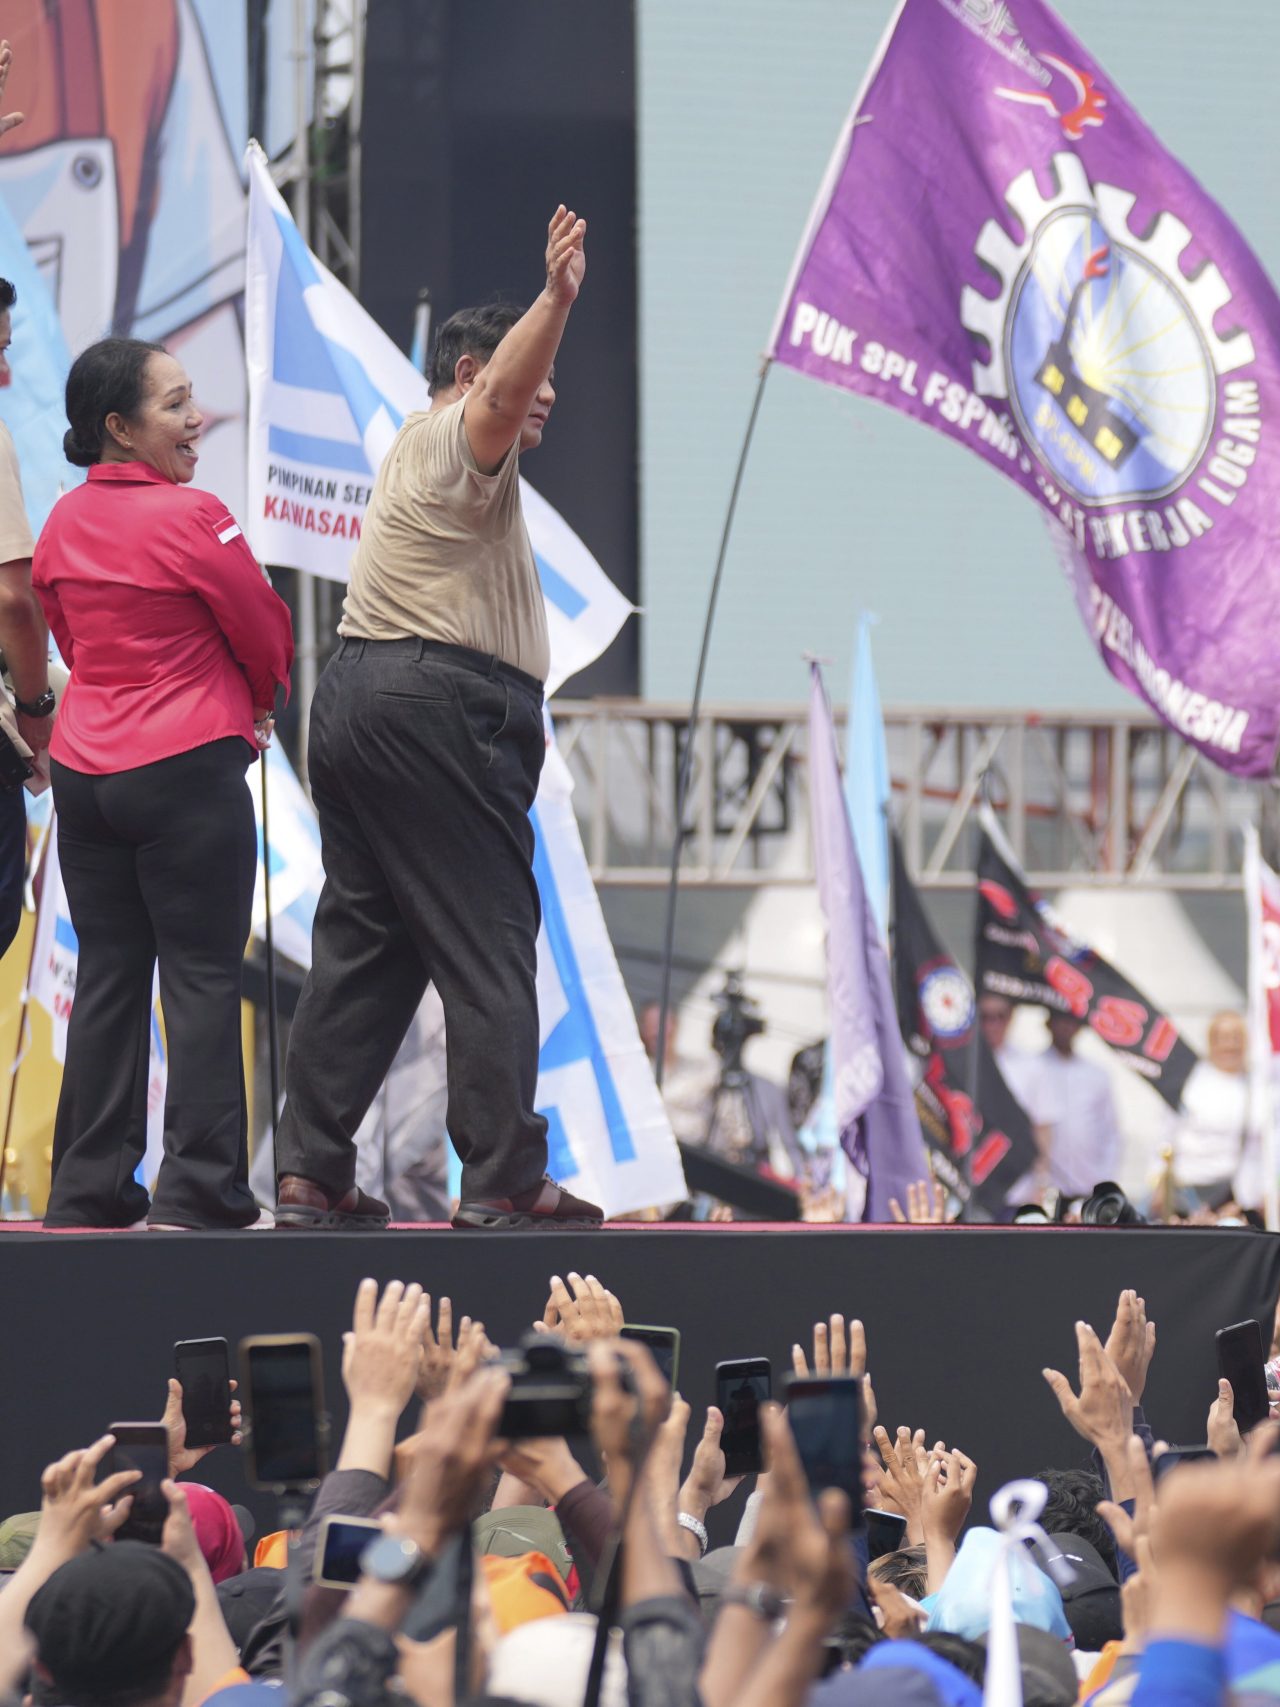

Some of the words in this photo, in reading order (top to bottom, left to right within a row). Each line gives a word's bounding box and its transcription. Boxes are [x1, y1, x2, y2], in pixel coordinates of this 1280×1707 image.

[789, 302, 858, 366] PUK
[267, 463, 337, 500] PIMPINAN
[1088, 497, 1214, 560] PKERJA
[1197, 379, 1262, 506] LOGAM
[264, 495, 361, 542] KAWASAN
